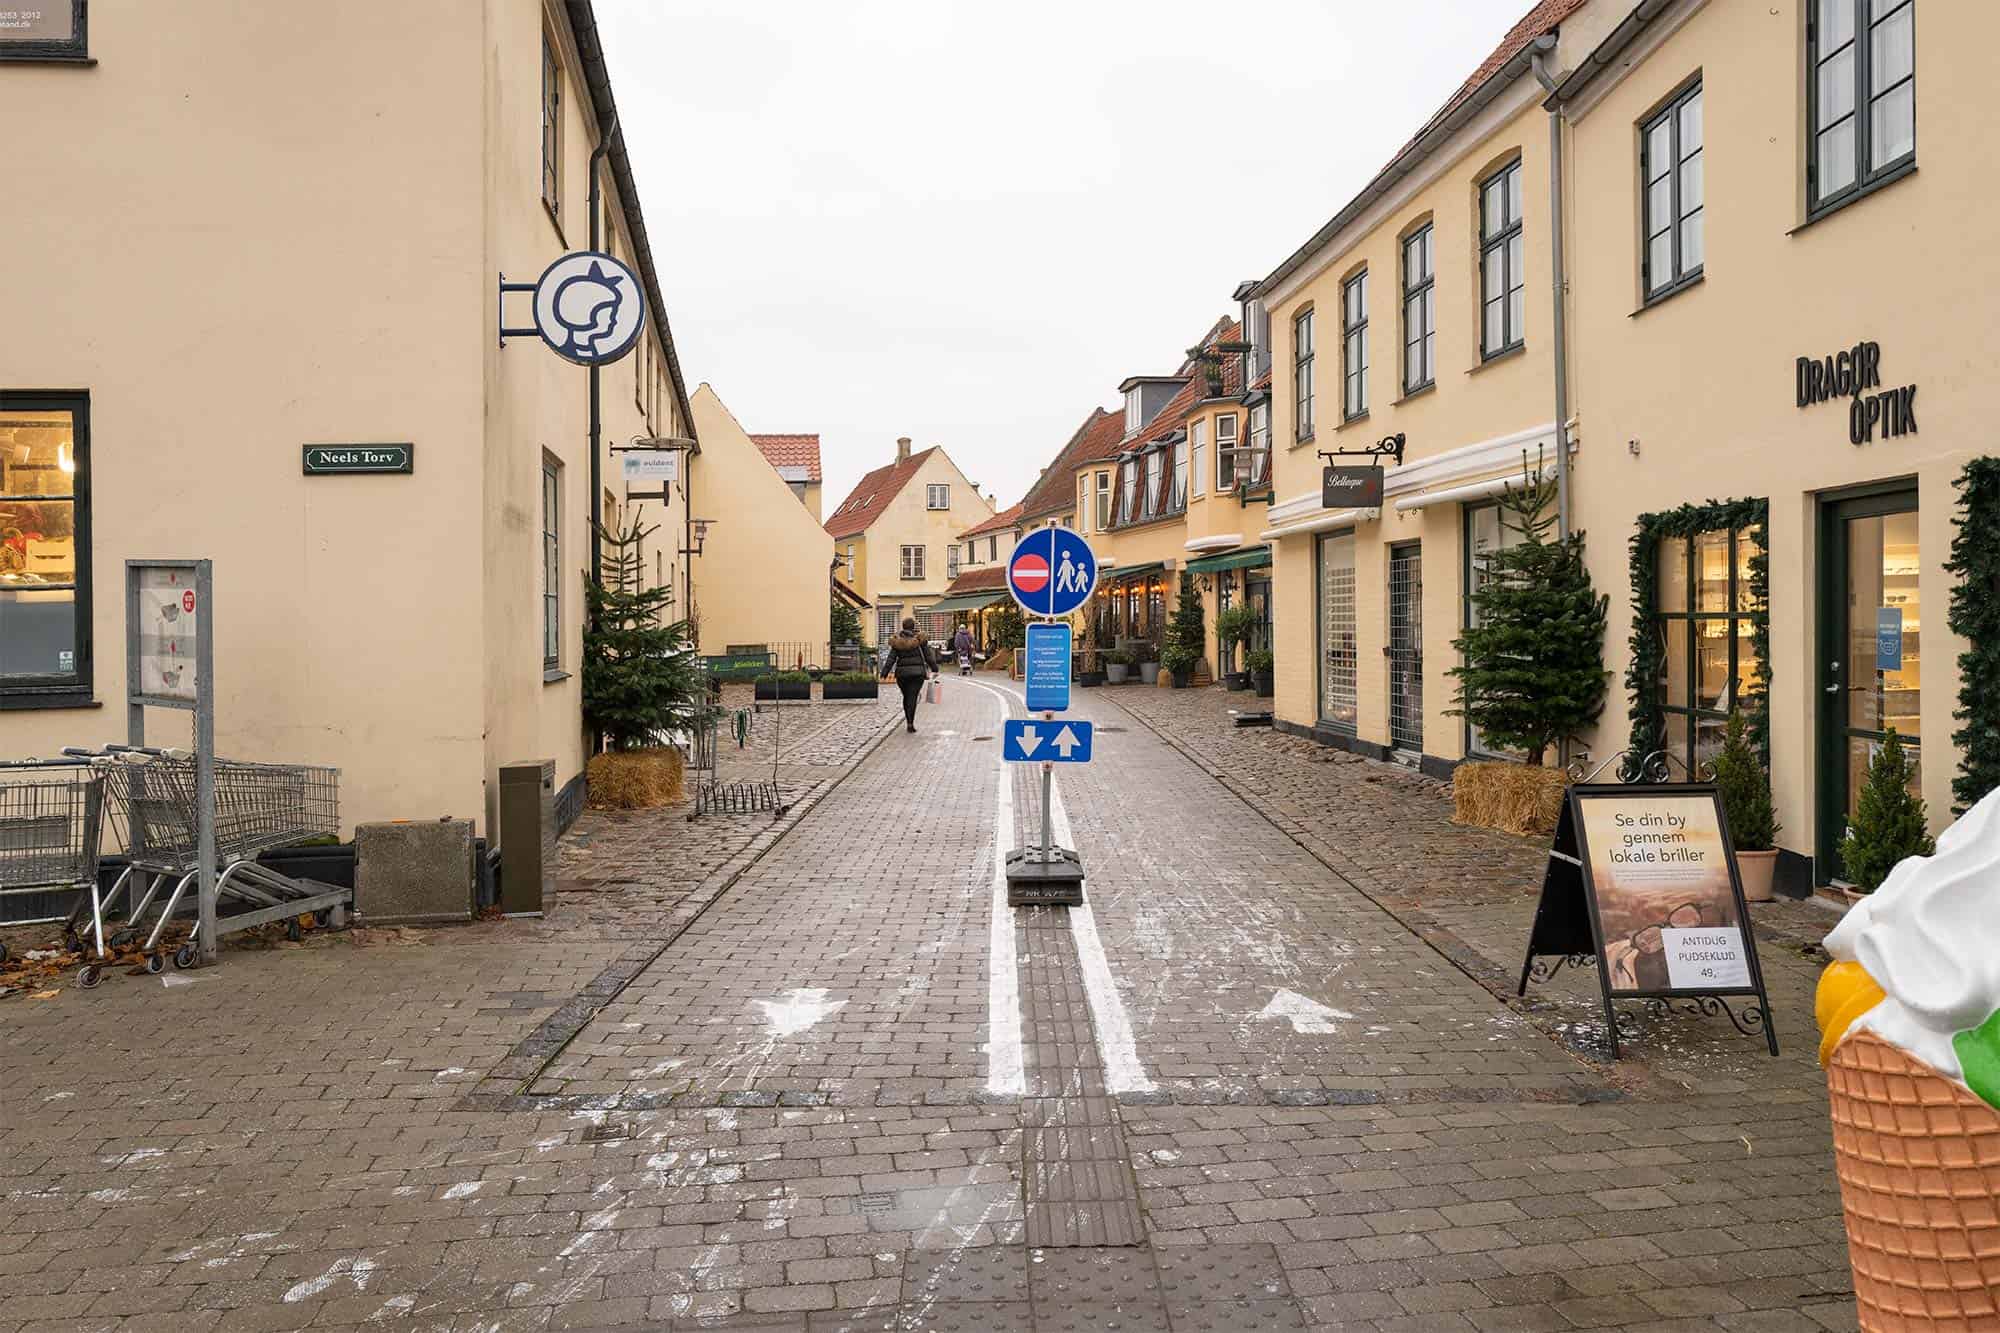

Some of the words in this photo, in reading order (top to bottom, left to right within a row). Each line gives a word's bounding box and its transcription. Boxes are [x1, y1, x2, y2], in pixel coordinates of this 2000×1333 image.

[1796, 340, 1881, 408] DRAGØR
[1849, 383, 1918, 445] OPTIK
[320, 451, 359, 463] Neels
[361, 451, 394, 463] Torv
[1615, 813, 1635, 826] Se
[1639, 812, 1663, 826] din
[1667, 812, 1686, 829] by
[1623, 833, 1686, 847] gennem
[1609, 849, 1656, 863] lokale
[1659, 848, 1705, 862] briller
[1682, 936, 1727, 946] ANTIDUG
[1678, 951, 1736, 961] PUDSEKLUD
